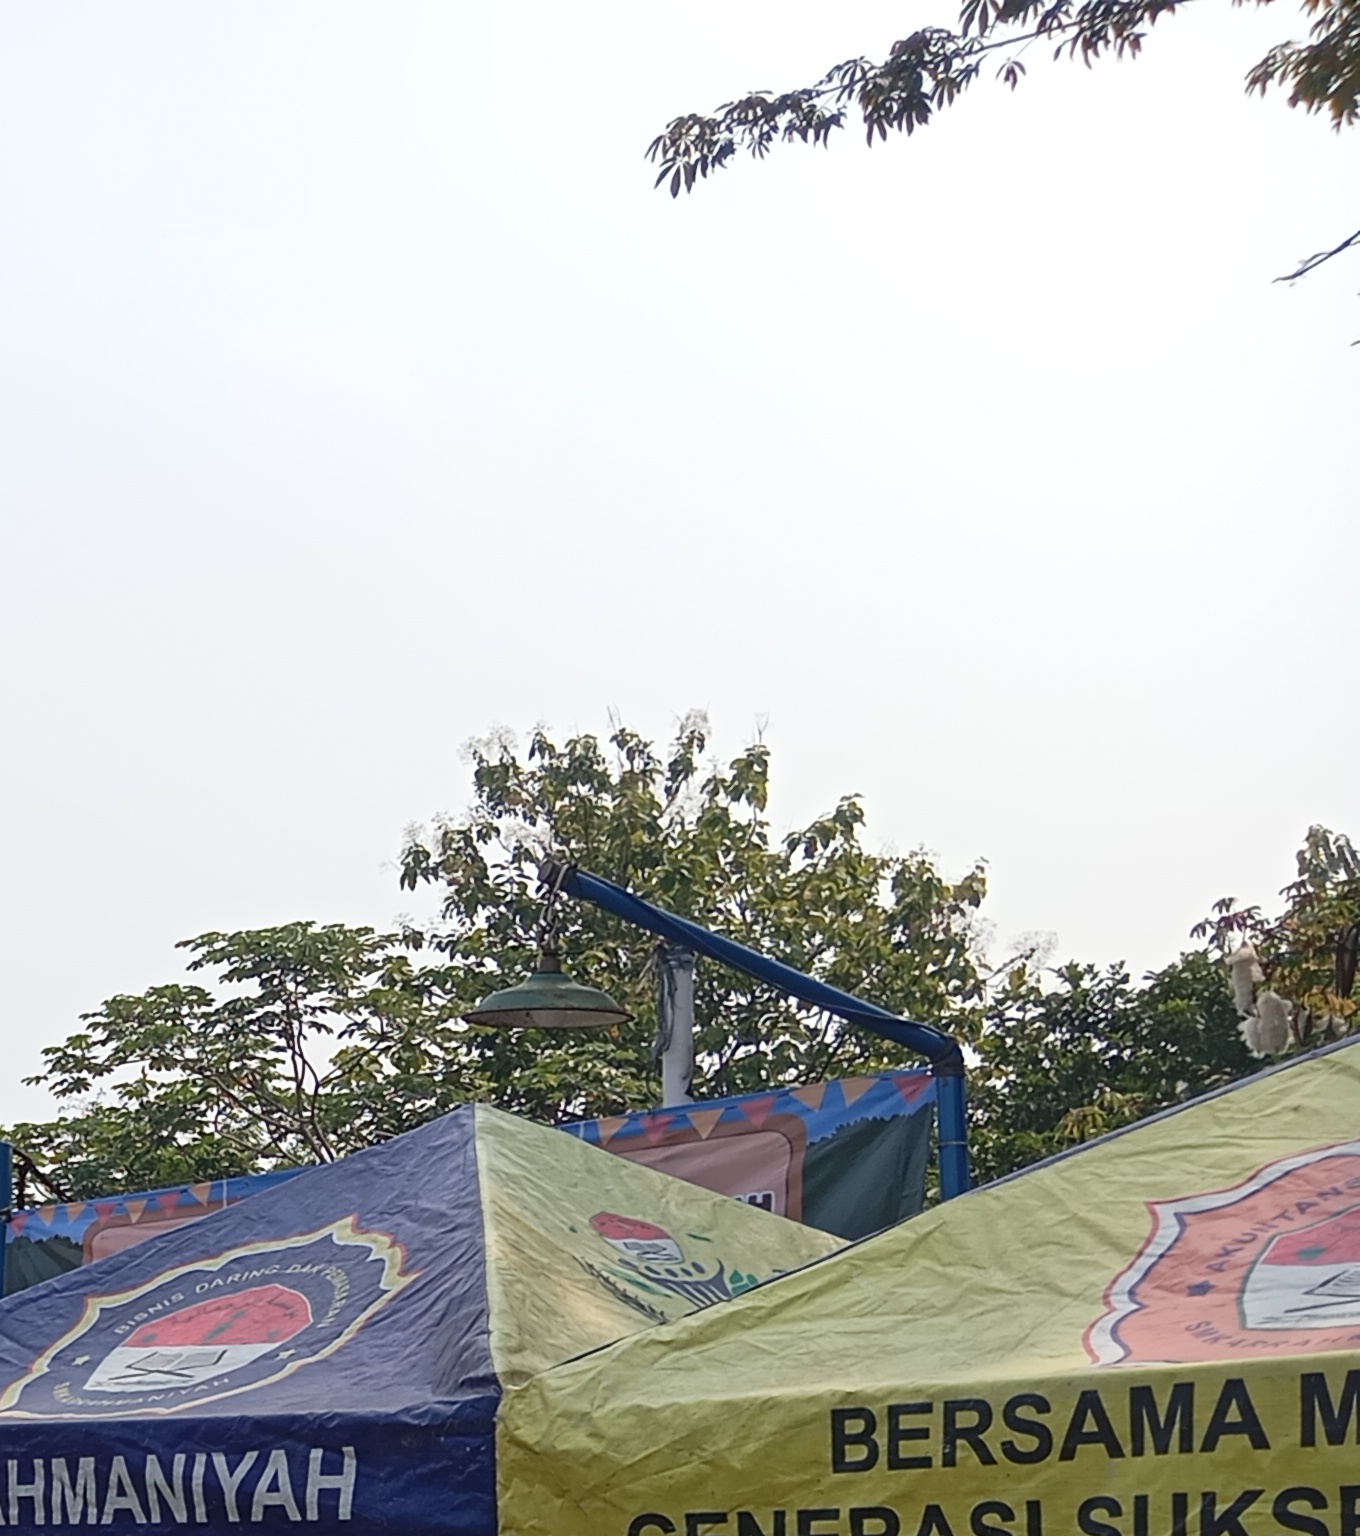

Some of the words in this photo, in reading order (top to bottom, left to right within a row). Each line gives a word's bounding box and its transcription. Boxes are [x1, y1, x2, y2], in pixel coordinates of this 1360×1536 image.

[113, 1292, 185, 1335] BISNIS
[195, 1264, 281, 1294] DARING
[829, 1378, 1272, 1474] BERSAMA
